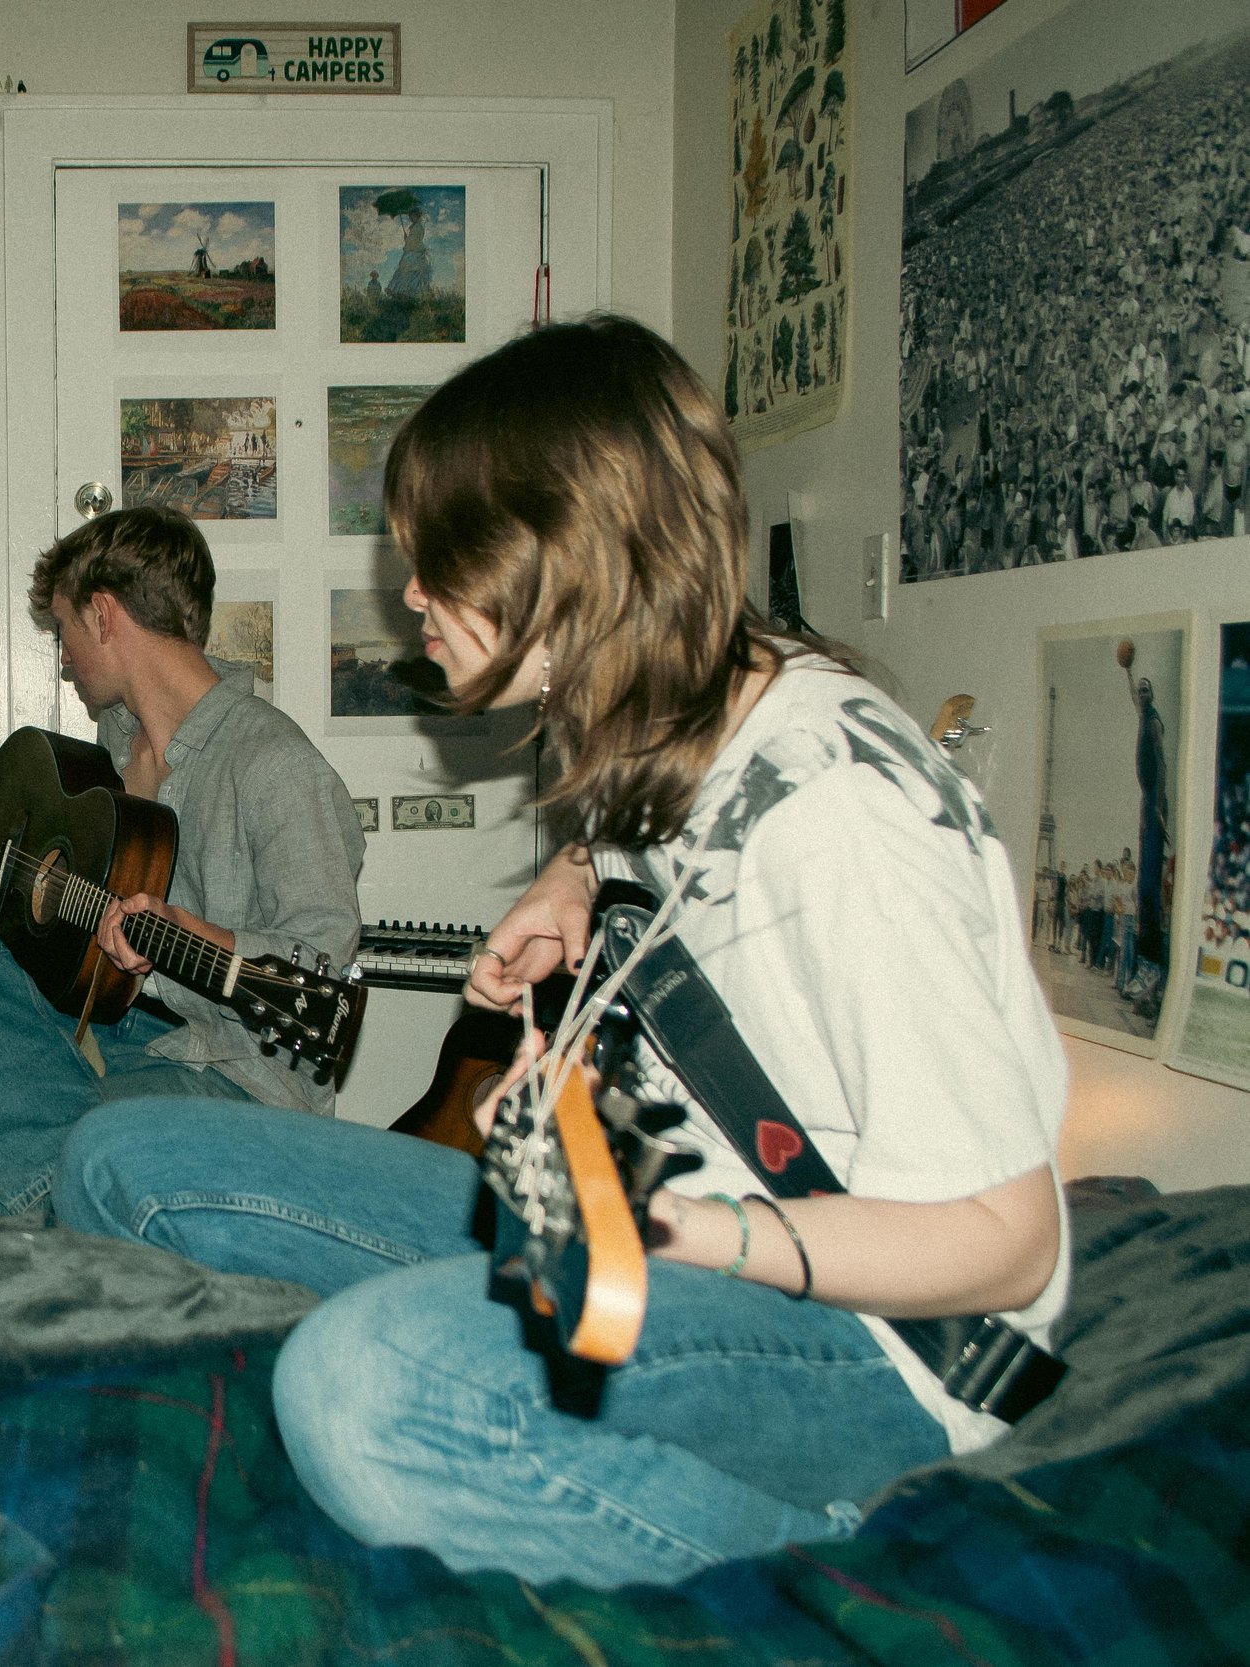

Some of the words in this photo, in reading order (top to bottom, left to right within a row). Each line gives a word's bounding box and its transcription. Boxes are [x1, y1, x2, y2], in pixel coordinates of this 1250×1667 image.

[308, 36, 383, 59] HAPPY
[284, 60, 385, 83] CAMPERS
[327, 992, 350, 1045] Ibanez
